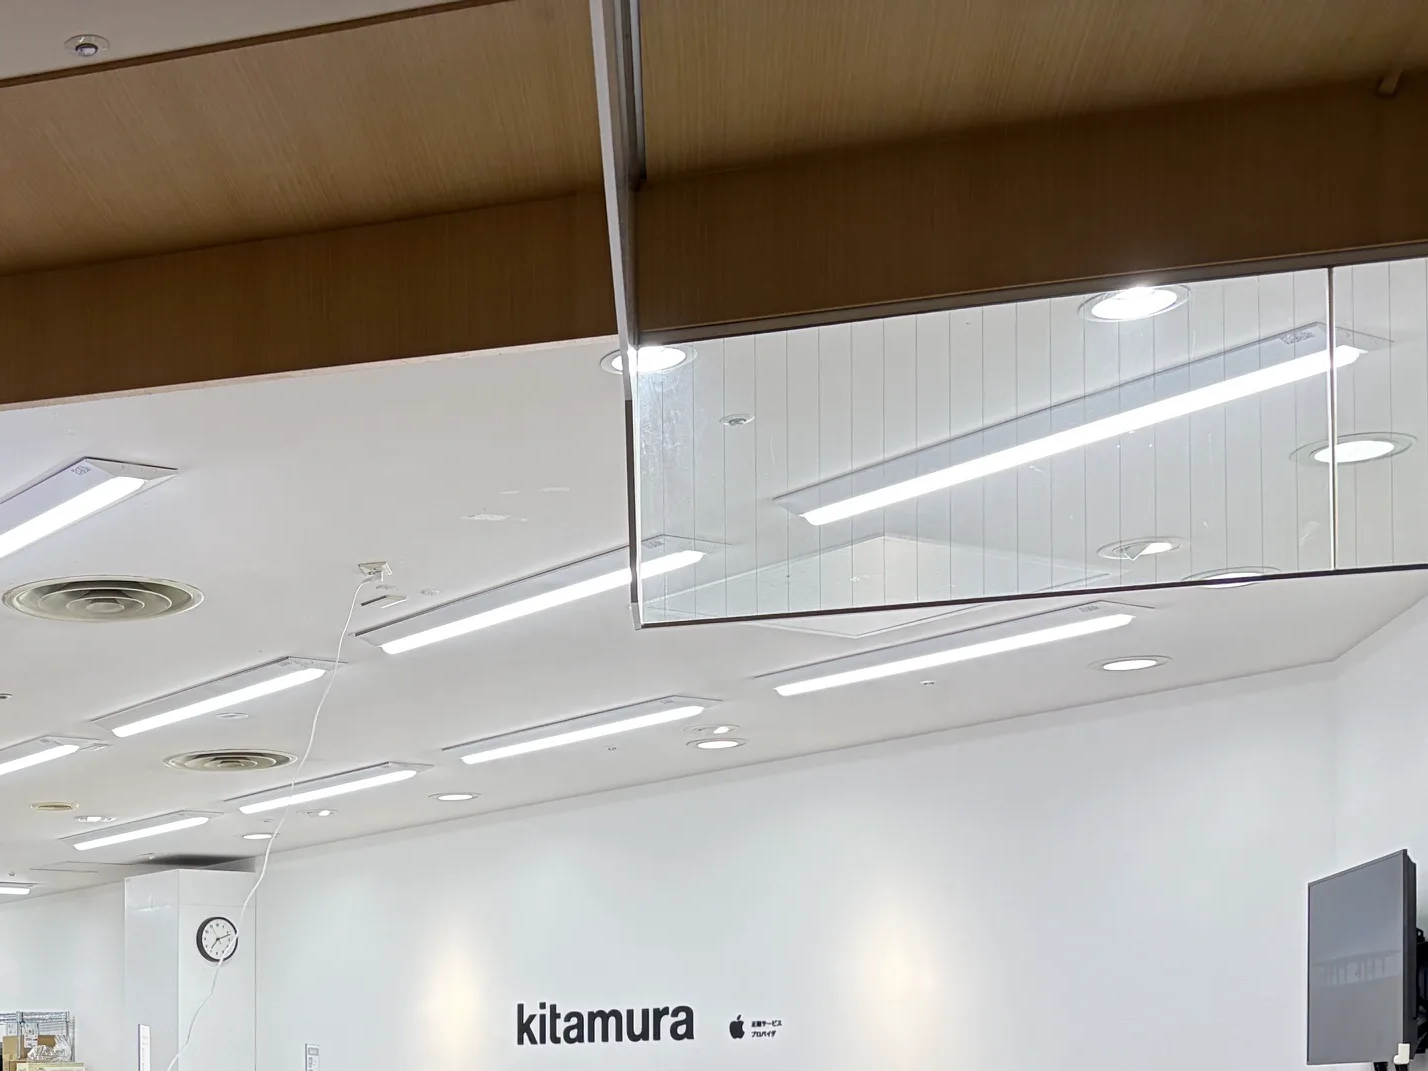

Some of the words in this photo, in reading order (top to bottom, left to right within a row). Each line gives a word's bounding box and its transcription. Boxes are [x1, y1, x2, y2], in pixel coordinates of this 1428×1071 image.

[516, 1001, 695, 1046] kitamura
[751, 1019, 782, 1027] 正規サービス
[751, 1030, 777, 1038] プロバイダ
